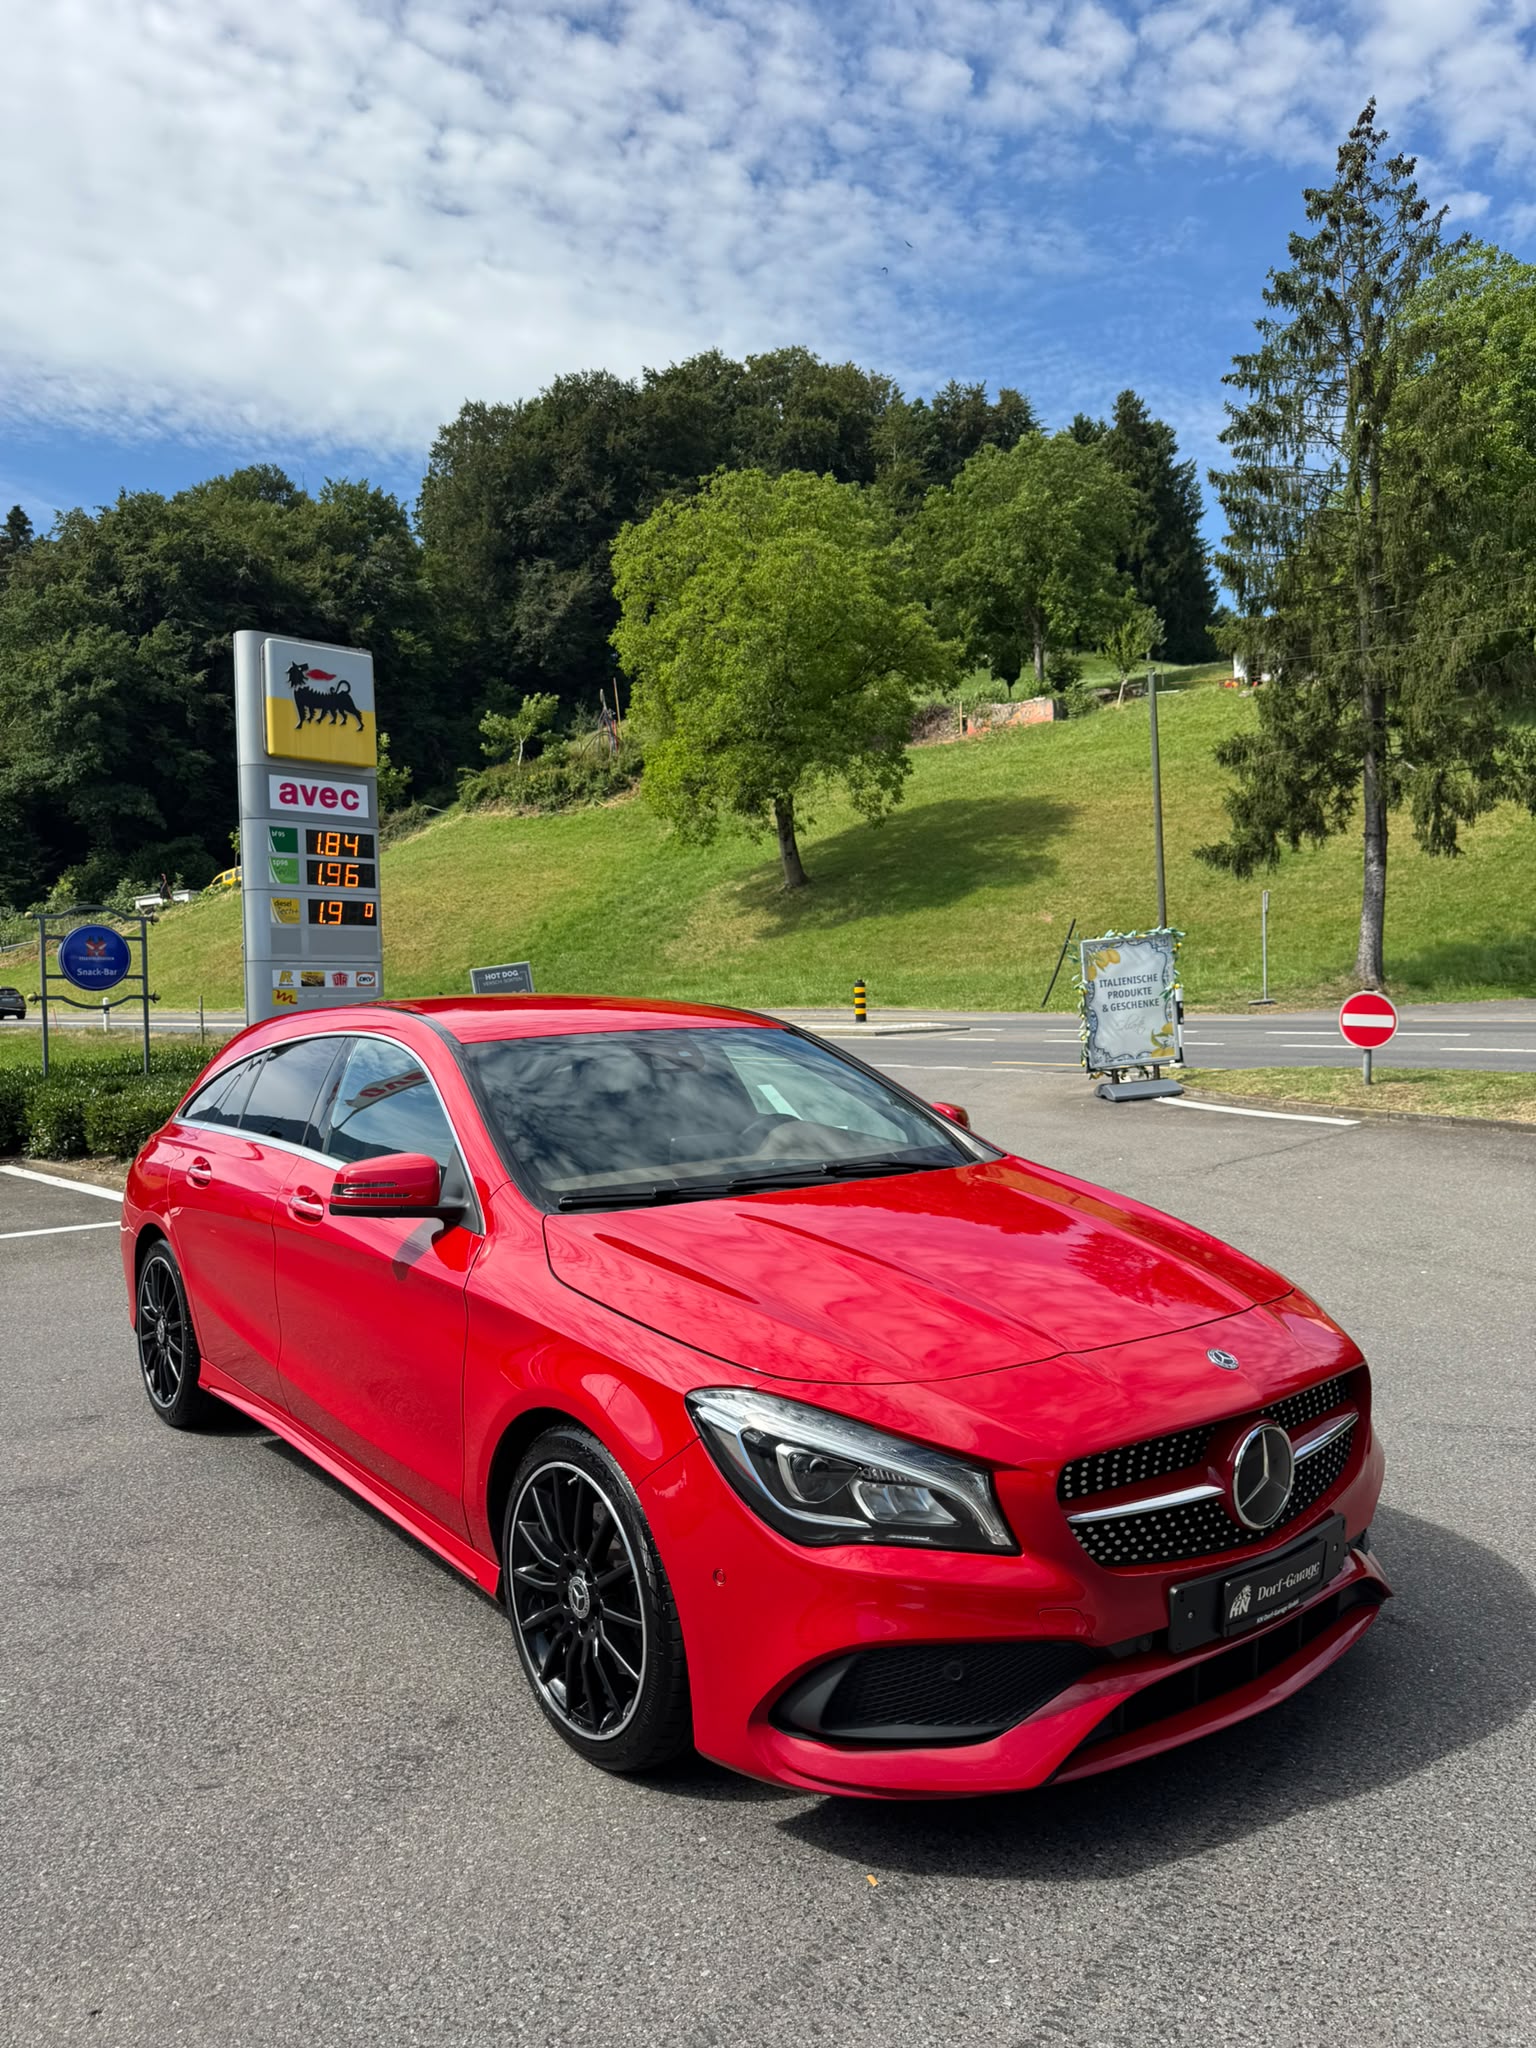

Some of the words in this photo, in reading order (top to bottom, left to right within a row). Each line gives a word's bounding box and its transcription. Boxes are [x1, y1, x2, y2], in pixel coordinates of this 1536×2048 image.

[279, 782, 359, 811] avec
[317, 832, 359, 857] 1.84
[318, 863, 359, 888] 1.96
[77, 968, 117, 976] Snack-Bar
[502, 970, 518, 978] DOG
[1099, 973, 1158, 988] ITALIENISCHE
[1107, 987, 1152, 999] PRODUKTE
[1102, 1003, 1109, 1013] &
[1110, 999, 1160, 1010] GESCHENKE
[1257, 1561, 1320, 1601] Dorf-Garage
